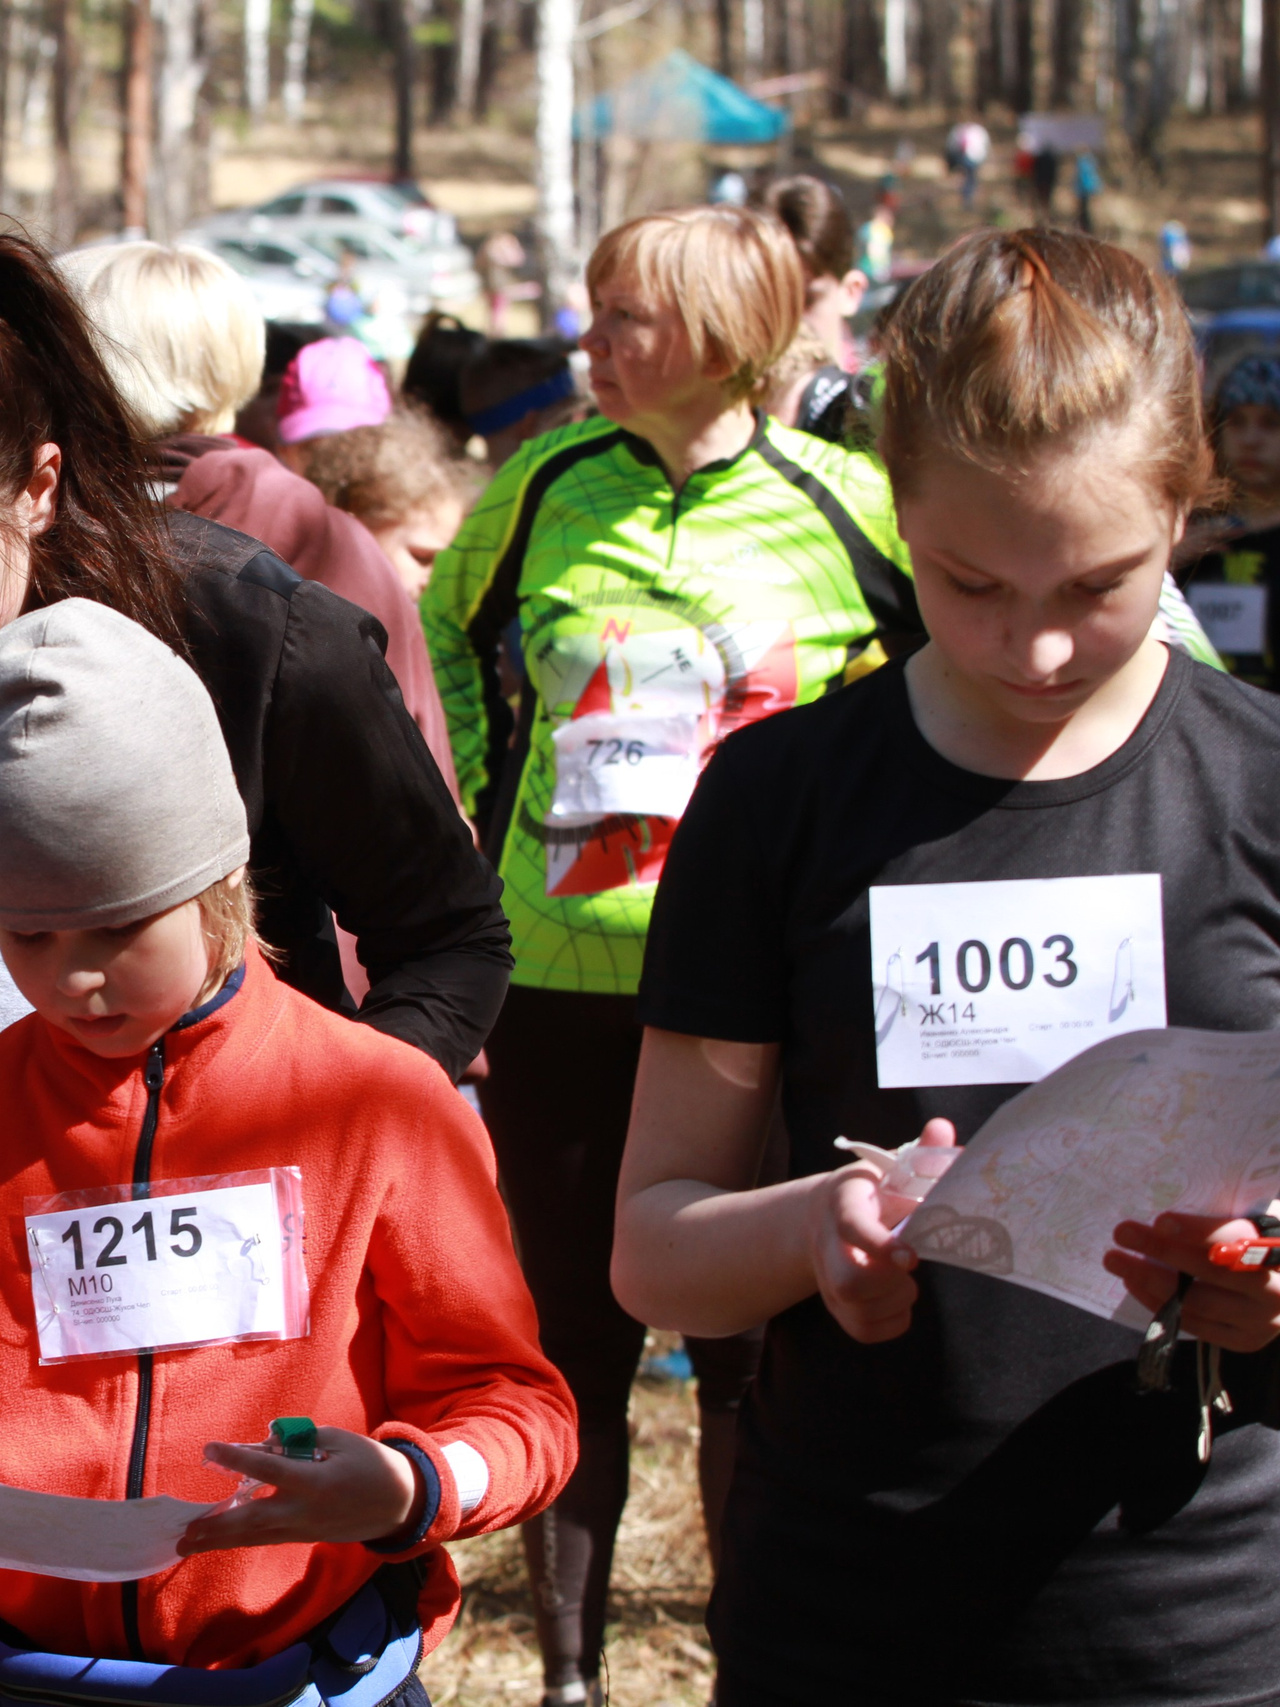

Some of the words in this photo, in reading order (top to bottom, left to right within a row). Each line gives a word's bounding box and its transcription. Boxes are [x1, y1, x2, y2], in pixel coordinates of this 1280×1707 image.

[601, 618, 632, 644] N
[672, 648, 692, 672] NE
[586, 739, 645, 766] 726
[915, 934, 1078, 995] 1003
[918, 1002, 976, 1025] Ж14
[61, 1207, 202, 1270] 1215
[68, 1274, 113, 1297] М10
